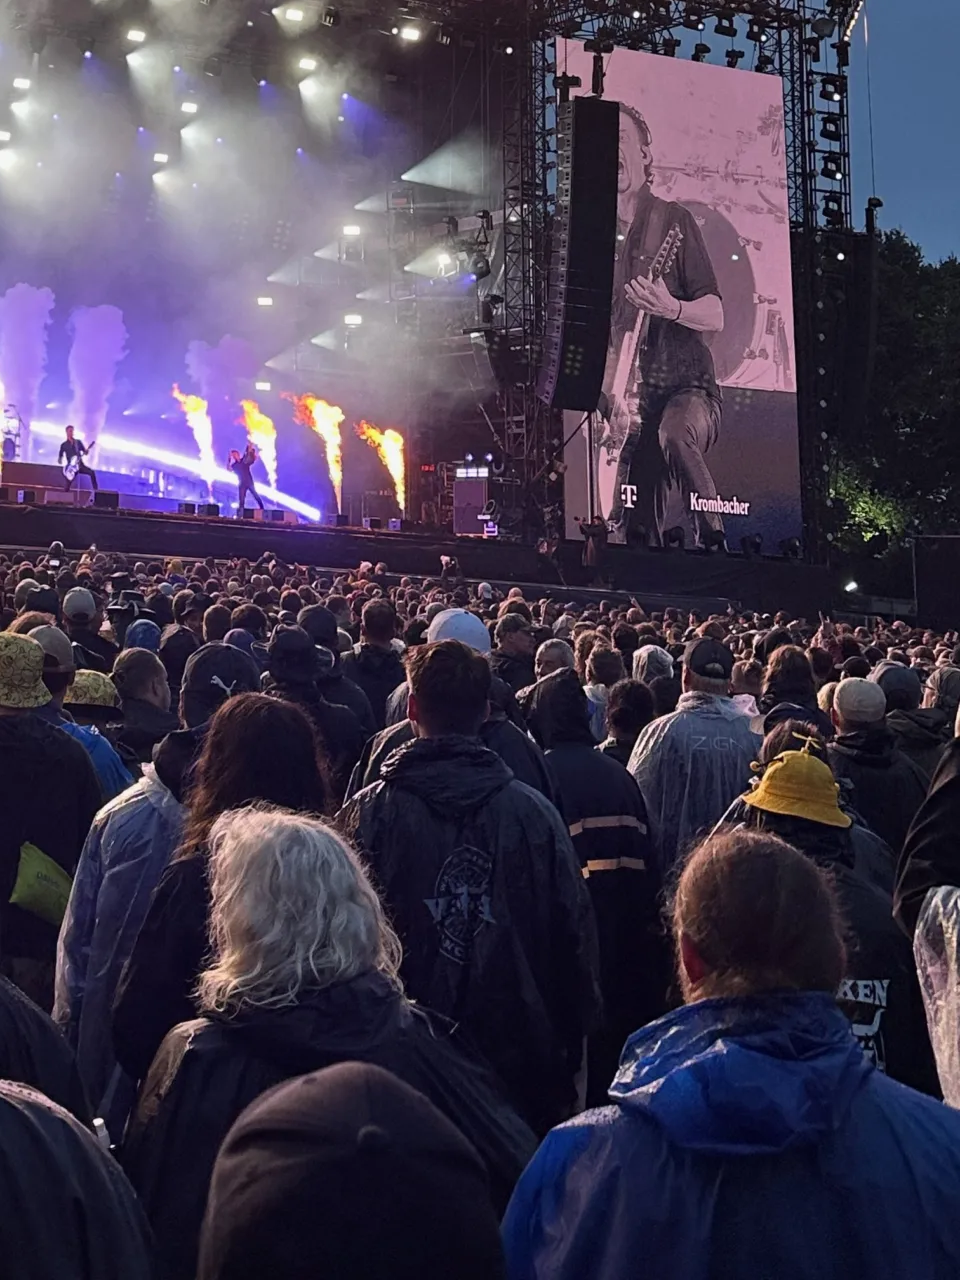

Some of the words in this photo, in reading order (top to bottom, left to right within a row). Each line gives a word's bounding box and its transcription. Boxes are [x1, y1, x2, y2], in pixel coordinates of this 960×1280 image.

[620, 484, 637, 509] T
[689, 492, 750, 516] Krombacher
[835, 978, 891, 1008] KEN
